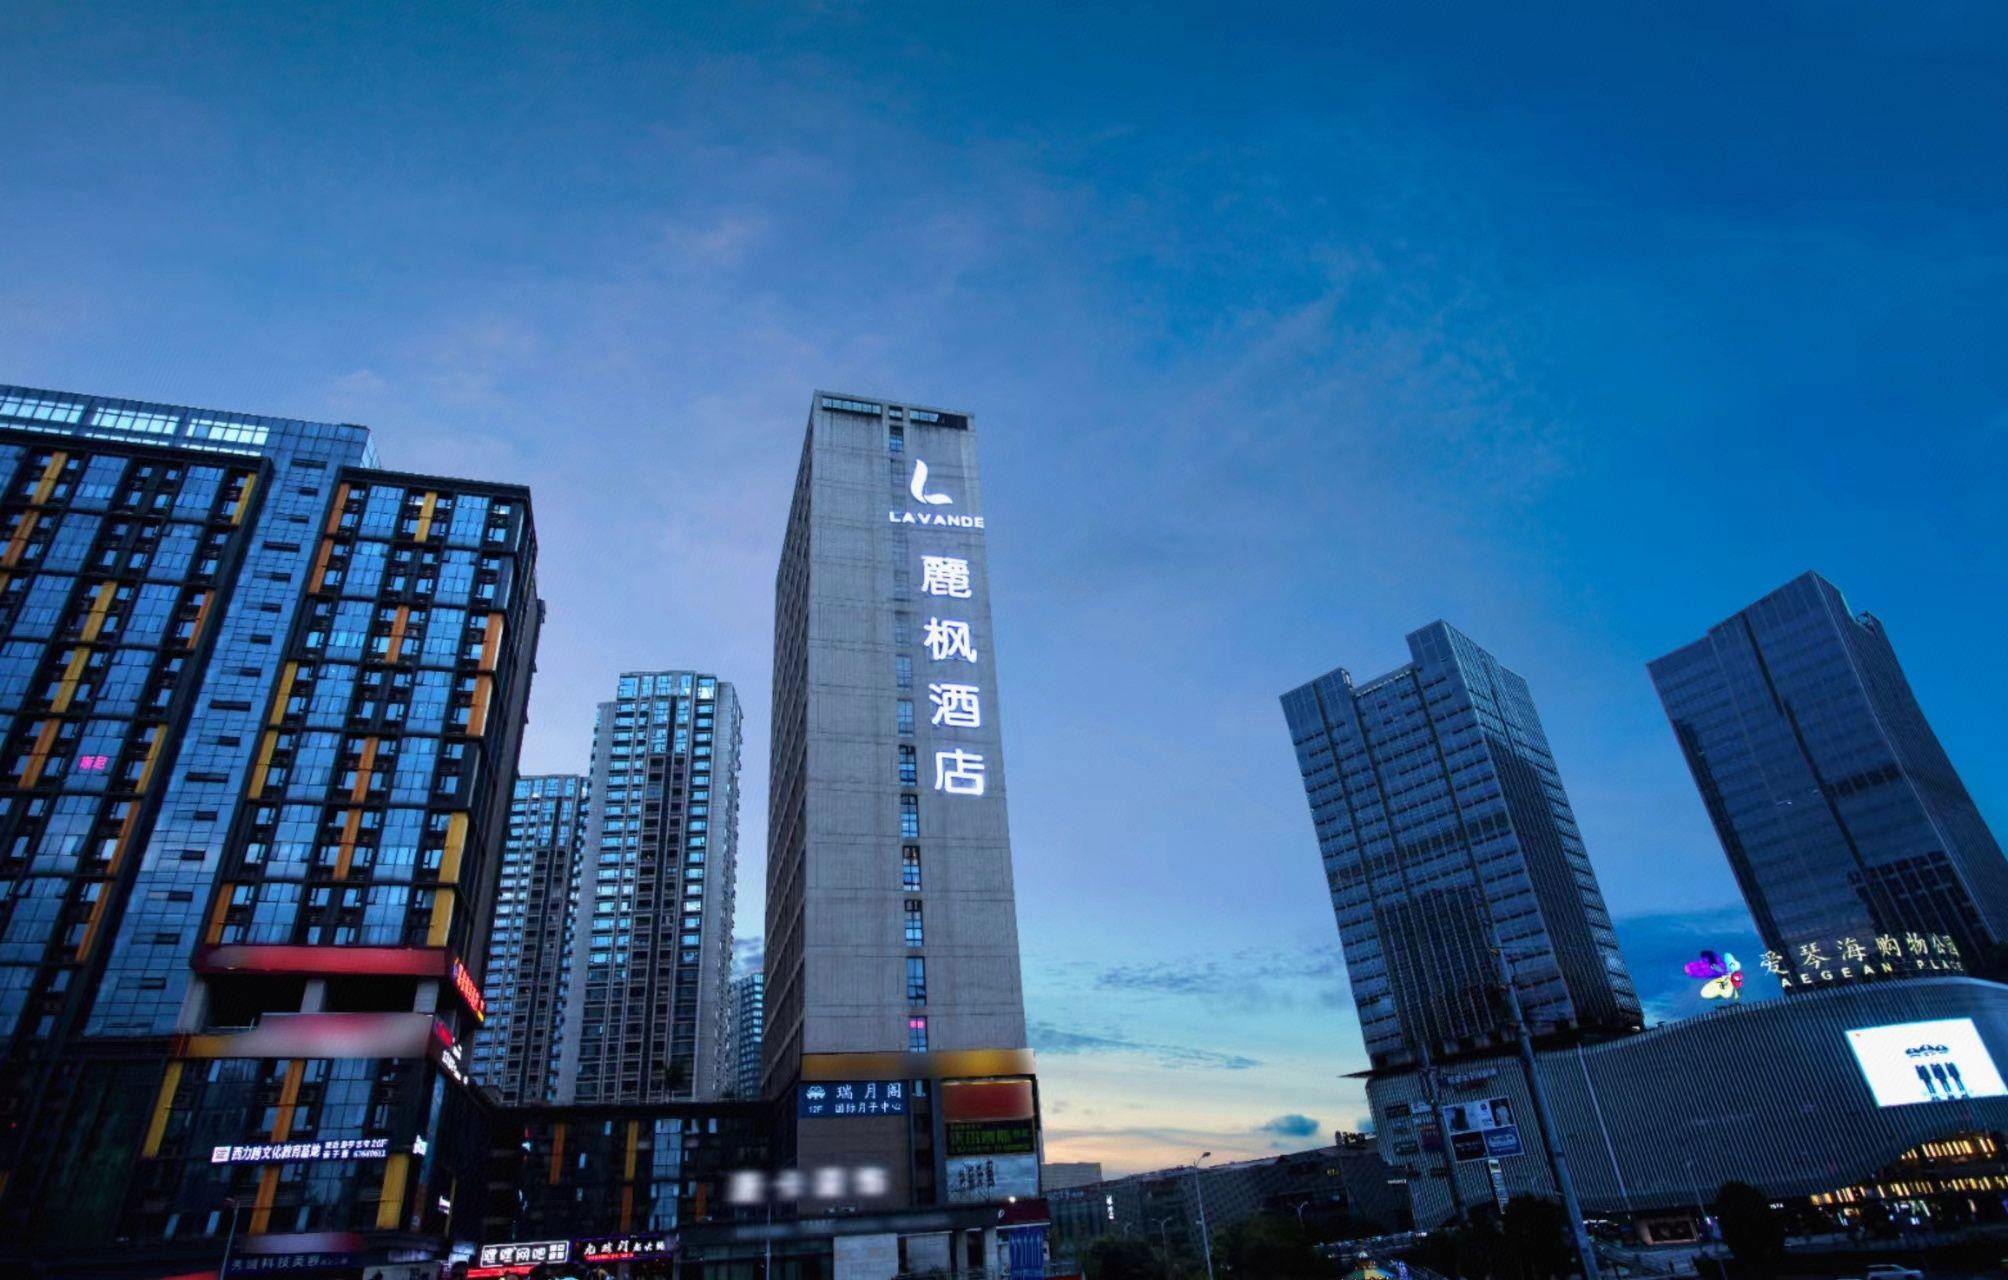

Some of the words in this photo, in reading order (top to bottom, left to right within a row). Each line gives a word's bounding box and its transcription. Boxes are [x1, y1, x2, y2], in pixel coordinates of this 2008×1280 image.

[889, 511, 985, 528] LAVANDE
[1781, 962, 1893, 988] AEGEAN
[835, 1101, 902, 1114] 国际月子中心
